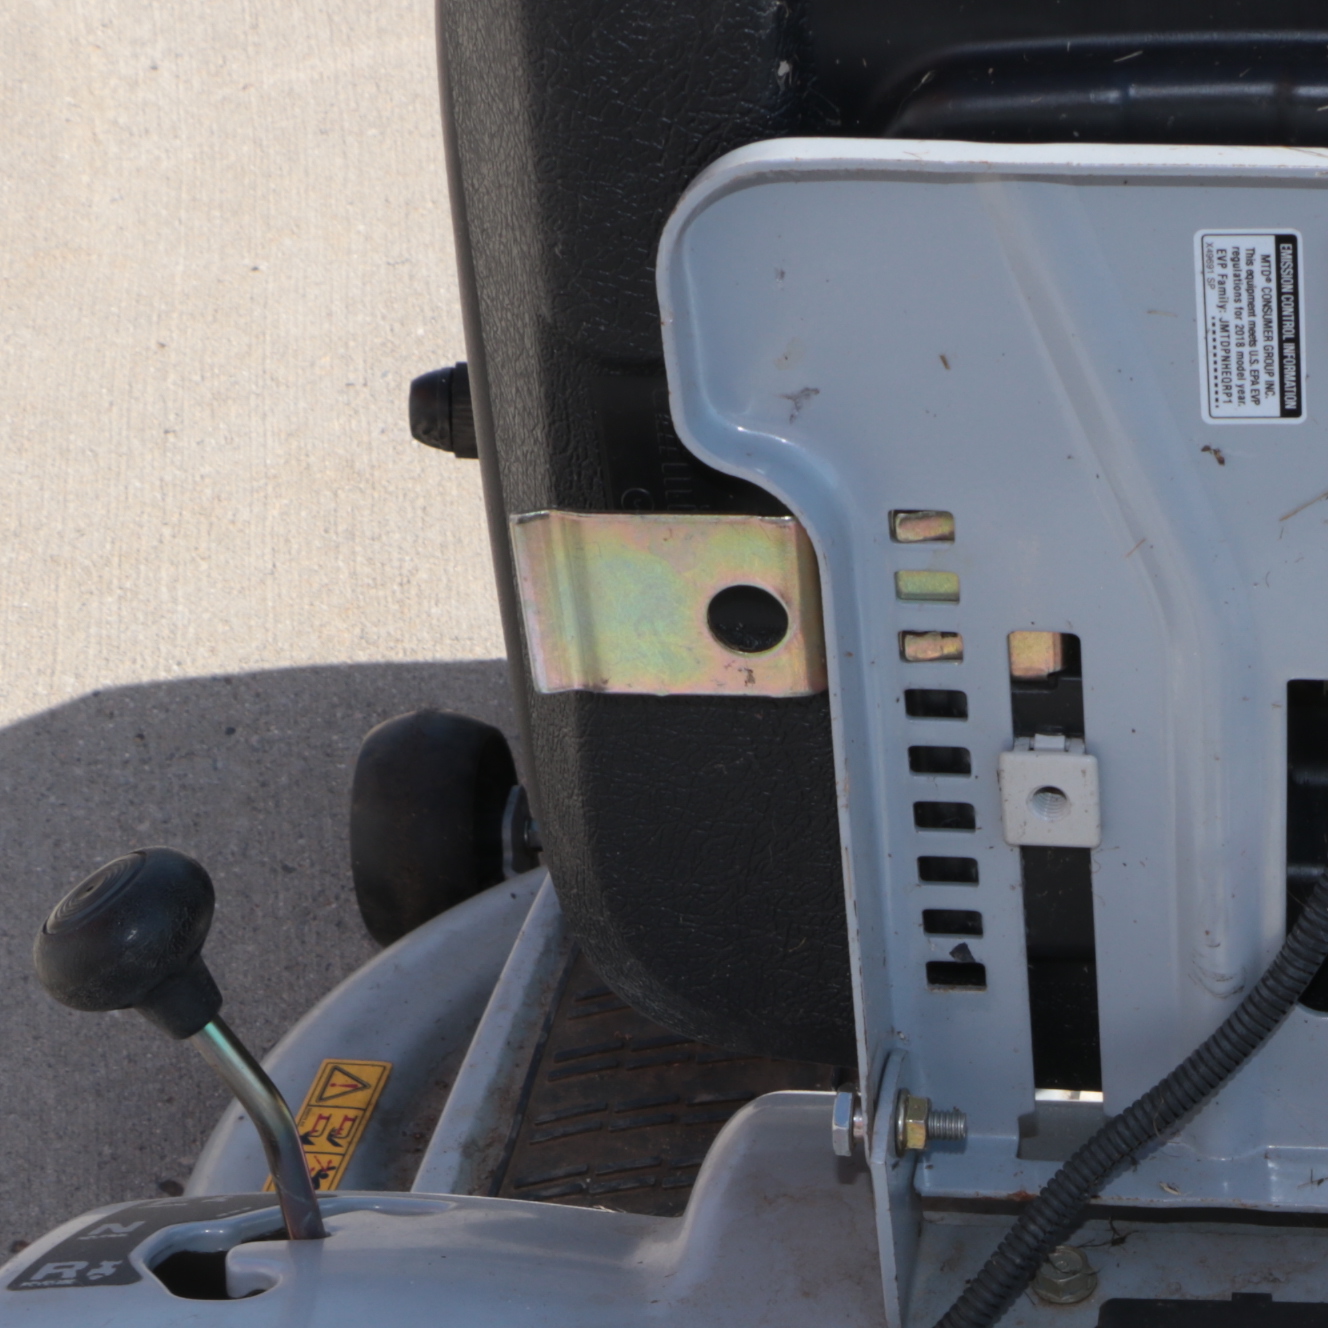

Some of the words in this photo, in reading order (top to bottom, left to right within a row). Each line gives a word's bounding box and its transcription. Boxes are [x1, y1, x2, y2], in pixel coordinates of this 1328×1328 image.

[1216, 249, 1227, 269] EVP
[1245, 248, 1255, 266] This
[1280, 244, 1294, 292] EMISSION
[1207, 278, 1214, 289] SP
[1231, 247, 1242, 303] regulations
[1217, 274, 1229, 313] Family:
[1244, 270, 1257, 317] equipment
[1234, 307, 1243, 320] for
[1262, 287, 1273, 342] CONSUMER
[1282, 295, 1295, 340] CONTROL
[1235, 324, 1244, 348] 2018
[1248, 320, 1257, 347] meets
[1237, 351, 1245, 380] model
[1249, 350, 1258, 367] U.S.
[1263, 345, 1274, 377] GROUP
[1250, 370, 1259, 386] EPA
[1283, 343, 1297, 409] INFORMATION
[1235, 384, 1246, 406] year.
[1251, 389, 1260, 405] EVP
[1265, 380, 1275, 399] INC.
[88, 1221, 146, 1235] N
[30, 1261, 88, 1280] R
